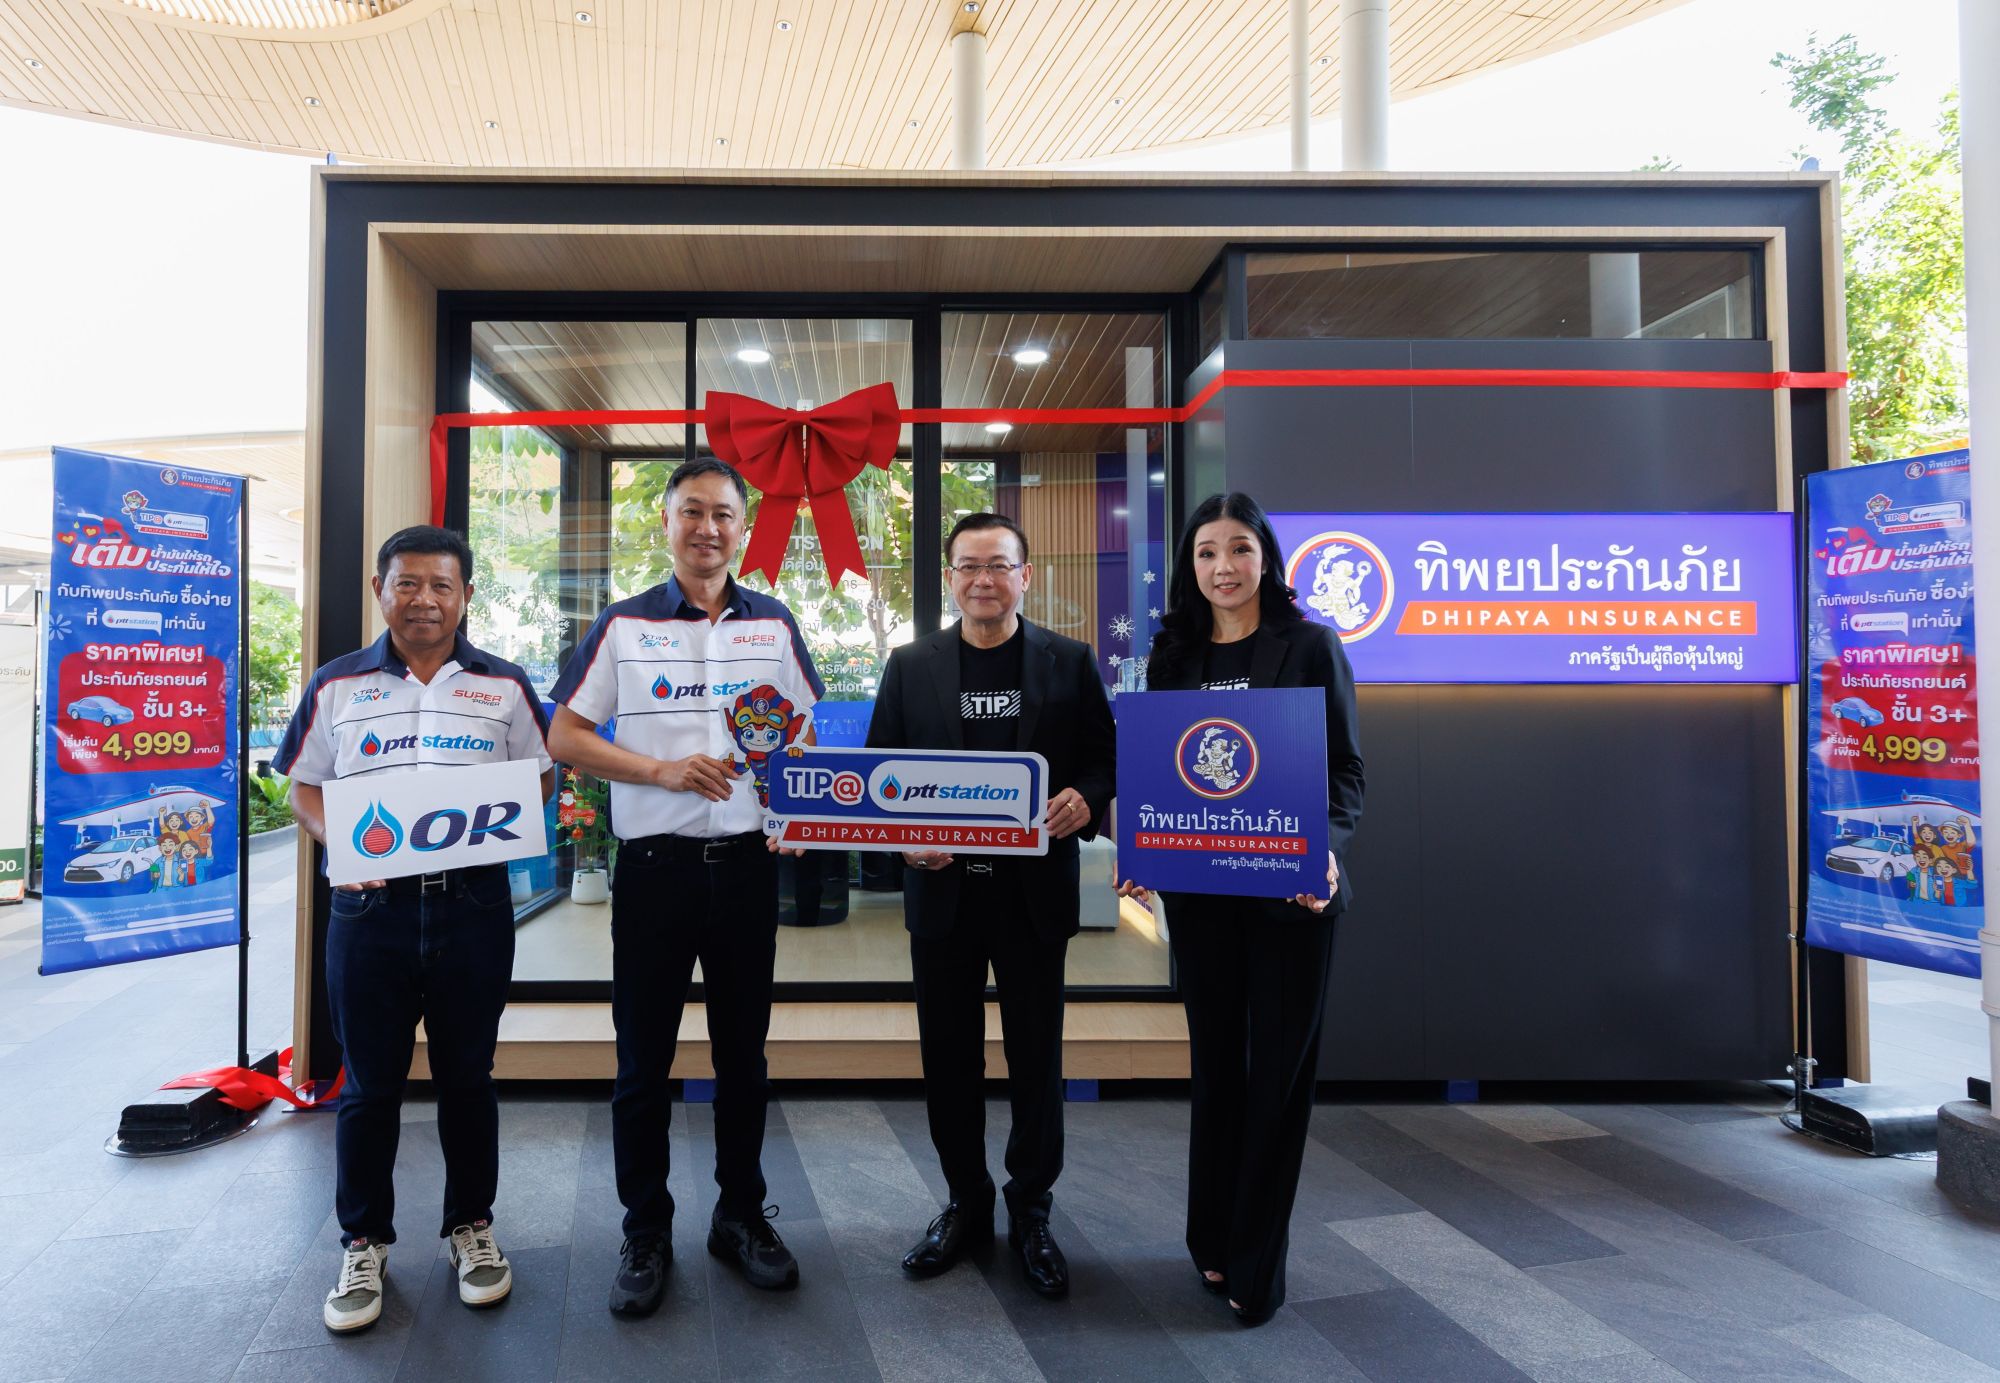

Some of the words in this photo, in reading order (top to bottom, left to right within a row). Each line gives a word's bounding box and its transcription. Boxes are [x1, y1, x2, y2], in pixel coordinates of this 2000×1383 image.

[72, 538, 147, 567] เติม
[1827, 545, 1891, 575] เติม
[1414, 540, 1741, 592] ทิพยประกันภัย
[57, 583, 178, 604] กับทิพยประกันภัย
[181, 584, 231, 607] ซื้อง่าย
[1816, 589, 1927, 607] กับทิพยประกันภัย
[86, 608, 97, 625] ที่
[165, 613, 205, 631] เท่านั้น
[1422, 610, 1551, 627] DHIPAYA
[1568, 609, 1743, 627] INSURANCE
[1912, 609, 1962, 629] เท่านั้น
[641, 640, 680, 648] SAVE
[731, 634, 776, 645] SUPER
[86, 643, 202, 662] ราคาพิเศษ!
[1568, 644, 1744, 671] ภาครัฐเป็นผู้ถือหุ้นใหญ่
[1844, 644, 1959, 664] ราคาพิเศษ!
[81, 670, 207, 686] ประกันภัยรถยนต์
[1841, 673, 1967, 689] ประกันภัยรถยนต์
[143, 691, 173, 718] ชั้น
[179, 701, 207, 718] 3+
[352, 691, 391, 704] SAVE
[452, 689, 503, 702] SUPER
[970, 694, 1010, 715] TIP
[1891, 694, 1922, 722] ชั้น
[1930, 705, 1967, 723] 3+
[64, 734, 98, 747] เริ่มต้น
[102, 731, 191, 761] 4,999
[194, 745, 219, 754] บาท/ปี
[422, 734, 495, 753] station
[1862, 735, 1947, 764] 4,999
[786, 770, 862, 802] TIP@
[409, 801, 522, 853] OR
[1138, 804, 1299, 834] ทิพยประกันภัย
[767, 819, 785, 830] BY
[801, 826, 889, 840] DHIPAYA
[901, 829, 1020, 844] INSURANCE
[1142, 836, 1203, 847] DHIPAYA
[1211, 838, 1300, 850] INSURANCE
